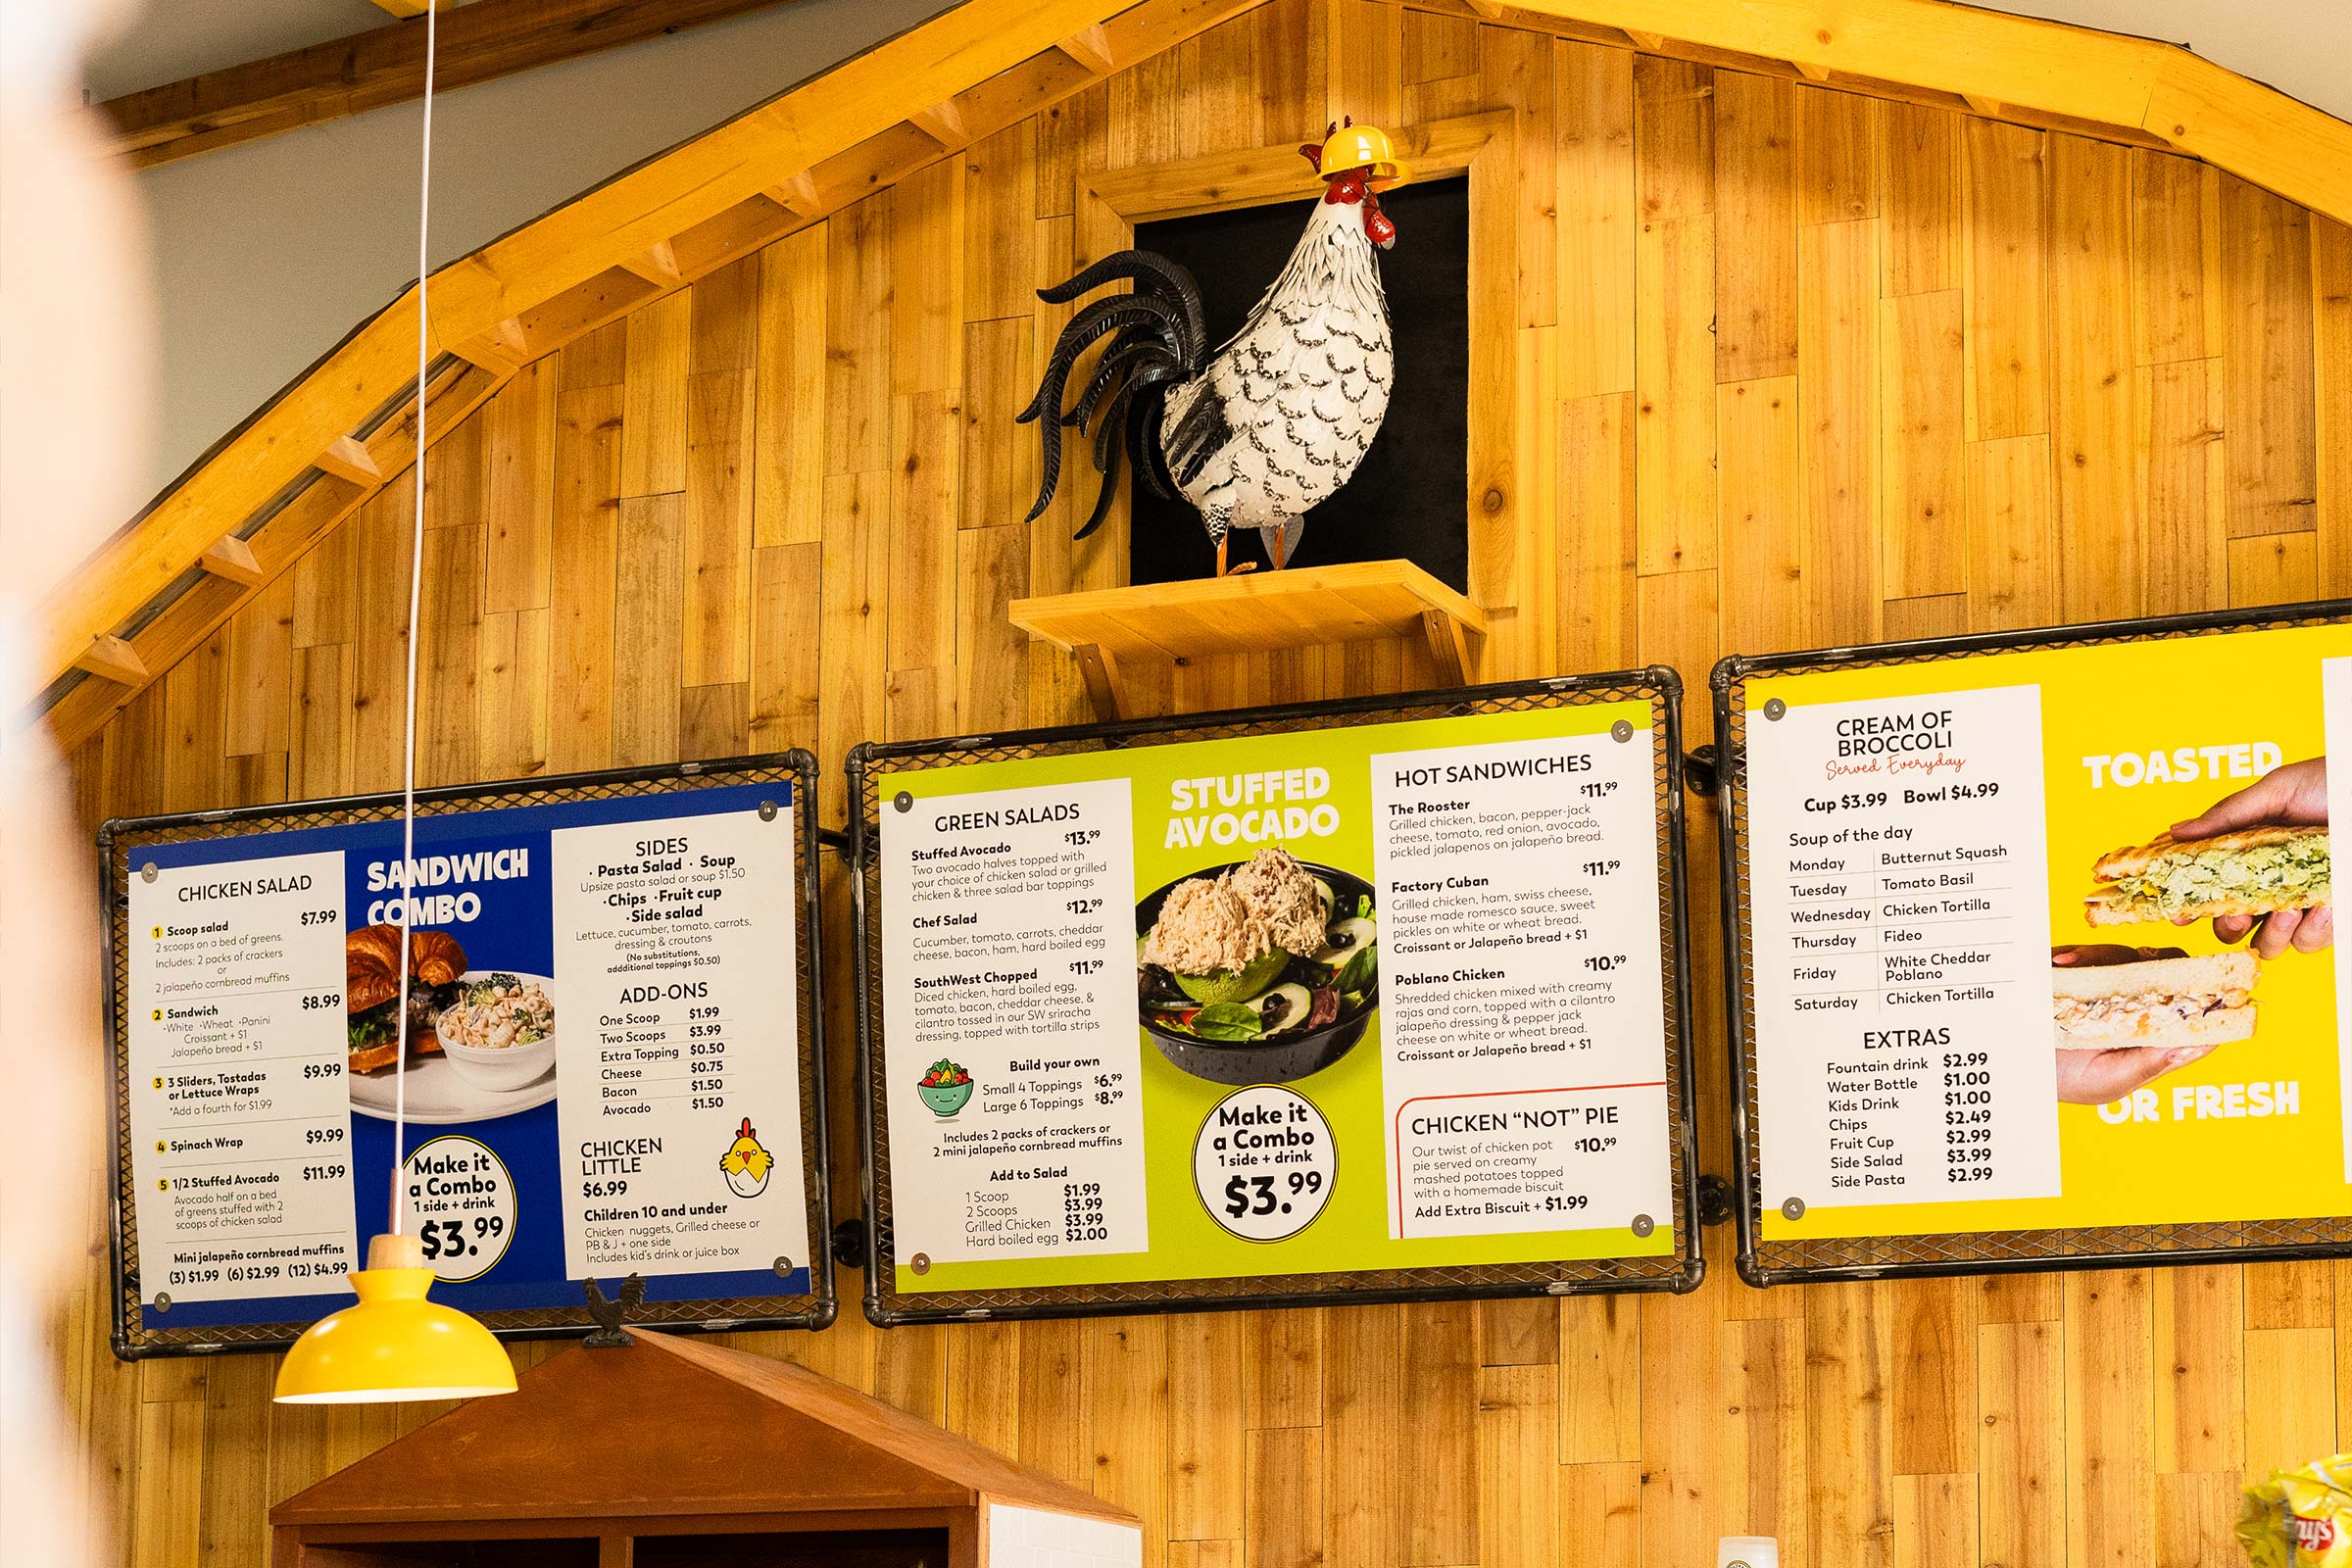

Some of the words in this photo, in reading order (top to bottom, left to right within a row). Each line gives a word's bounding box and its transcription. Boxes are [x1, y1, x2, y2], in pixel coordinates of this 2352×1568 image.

[1836, 712, 1914, 737] CREAM
[1921, 710, 1952, 729] OF
[1838, 730, 1951, 758] BROCCOLI
[1395, 767, 1442, 788] HOT
[1446, 754, 1592, 783] SANDWICHES
[1826, 757, 1882, 780] Served
[1886, 752, 1966, 776] Everyday
[2082, 741, 2283, 789] TOASTED
[1171, 766, 1330, 811] STUFFED
[1388, 803, 1414, 815] The
[1417, 800, 1470, 813] Rooster
[1580, 781, 1618, 798] $11.99
[1803, 798, 1837, 814] Cup
[1840, 792, 1887, 809] $3.99
[1903, 786, 1946, 804] Bowl
[1950, 782, 1999, 801] $4.99
[934, 810, 999, 832] GREEN
[1004, 803, 1080, 826] SALADS
[1164, 804, 1340, 849] AVOCADO
[1389, 817, 1426, 830] Grilled
[1429, 814, 1476, 827] chicken,
[1478, 811, 1518, 823] bacon,
[1521, 803, 1591, 822] pepper-jack
[635, 837, 688, 857] SIDES
[911, 846, 957, 861] Stuffed
[959, 841, 1011, 857] Avocado
[1064, 829, 1101, 846] $13.99
[1788, 832, 1829, 848] Soup
[1833, 828, 1849, 843] of
[1852, 827, 1879, 842] the
[1884, 825, 1913, 841] day
[367, 848, 528, 892] SANDWICH
[1789, 857, 1845, 872] Monday
[1881, 850, 1952, 865] Butternut
[1955, 844, 2007, 861] Squash
[177, 880, 252, 903] CHICKEN
[257, 874, 312, 895] SALAD
[580, 881, 613, 894] Upsize
[616, 878, 645, 891] pasta
[648, 873, 675, 886] salad
[691, 872, 715, 883] soup
[718, 866, 745, 880] $1.50
[1392, 881, 1443, 893] Factory
[1446, 875, 1489, 888] Cuban
[1583, 859, 1621, 876] $11.99
[1789, 882, 1847, 897] Tuesday
[1881, 877, 1936, 891] Tomato
[1939, 871, 1974, 886] Basil
[368, 892, 481, 927] COMBO
[912, 914, 941, 929] Chef
[943, 911, 977, 926] Salad
[1066, 898, 1102, 914] $12.99
[1790, 906, 1871, 923] Wednesday
[1883, 903, 1937, 916] Chicken
[1940, 898, 1990, 912] Tortilla
[154, 928, 160, 938] 1
[167, 925, 198, 937] Scoop
[200, 920, 228, 933] salad
[300, 909, 336, 926] $7.99
[1790, 933, 1856, 949] Thursday
[1884, 929, 1922, 943] Fideo
[1395, 972, 1449, 986] Poblano
[1452, 967, 1505, 981] Chicken
[1584, 955, 1627, 971] $10.99
[1884, 955, 1927, 968] White
[1930, 951, 1991, 965] Cheddar
[913, 973, 981, 989] SouthWest
[983, 967, 1038, 984] Chopped
[1069, 959, 1103, 975] $11.99
[1793, 966, 1837, 981] Friday
[1886, 968, 1942, 982] Poblano
[619, 981, 708, 1004] ADD-ONS
[154, 1010, 161, 1020] 2
[167, 1004, 219, 1019] Sandwich
[302, 994, 340, 1010] $8.99
[599, 1014, 623, 1026] One
[625, 1012, 660, 1025] Scoop
[689, 1005, 719, 1020] $1.99
[599, 1033, 623, 1044] Two
[625, 1031, 665, 1043] Scoops
[689, 1024, 721, 1038] $3.99
[1863, 1027, 1950, 1050] EXTRAS
[155, 1078, 163, 1088] 3
[168, 1077, 174, 1088] 3
[176, 1075, 216, 1087] Sliders,
[217, 1070, 267, 1084] Tostadas
[304, 1062, 341, 1079] $9.99
[1009, 1058, 1041, 1072] Build
[1043, 1059, 1071, 1072] your
[1073, 1057, 1100, 1067] own
[1827, 1059, 1888, 1074] Fountain
[1892, 1056, 1929, 1070] drink
[1942, 1052, 1987, 1068] $2.99
[602, 1087, 637, 1098] Bacon
[691, 1078, 723, 1092] $1.50
[982, 1082, 1015, 1096] Small
[1017, 1082, 1026, 1093] 4
[1027, 1079, 1082, 1095] Toppings
[1094, 1072, 1122, 1087] $6.99
[602, 1102, 651, 1116] Avocado
[692, 1097, 723, 1110] $1.50
[983, 1101, 1016, 1114] Large
[1019, 1099, 1027, 1110] 6
[1029, 1097, 1084, 1111] Toppings
[1094, 1090, 1123, 1104] $8.99
[1219, 1104, 1283, 1127] Make
[1289, 1102, 1307, 1122] it
[2097, 1089, 2159, 1125] OR
[2173, 1081, 2299, 1120] FRESH
[1411, 1112, 1507, 1135] CHICKEN
[1585, 1105, 1619, 1125] PIE
[1829, 1118, 1868, 1133] Chips
[1945, 1108, 1991, 1125] $2.49
[158, 1143, 165, 1152] 4
[171, 1138, 213, 1153] Spinach
[214, 1137, 243, 1149] Wrap
[306, 1128, 343, 1145] $9.99
[580, 1137, 662, 1158] CHICKEN
[1213, 1137, 1227, 1151] a
[1234, 1126, 1314, 1149] Combo
[1574, 1137, 1617, 1152] $10.99
[1830, 1137, 1863, 1150] Fruit
[1866, 1136, 1894, 1151] Cup
[1945, 1128, 1991, 1145] $2.99
[581, 1156, 642, 1176] LITTLE
[1218, 1154, 1225, 1167] 1
[1229, 1153, 1258, 1166] side
[1262, 1154, 1271, 1163] +
[1275, 1150, 1312, 1164] drink
[1830, 1155, 1860, 1169] Side
[1863, 1152, 1902, 1167] Salad
[1946, 1148, 1991, 1164] $3.99
[161, 1181, 167, 1191] 5
[172, 1177, 189, 1191] 1/2
[191, 1174, 232, 1188] Stuffed
[233, 1171, 279, 1185] Avocado
[303, 1164, 345, 1181] $11.99
[989, 1168, 1014, 1182] Add
[1016, 1169, 1030, 1180] to
[1033, 1165, 1067, 1179] Salad
[582, 1180, 627, 1199] $6.99
[1225, 1170, 1322, 1219] $3.99
[1414, 1204, 1441, 1218] Add
[1445, 1204, 1481, 1216] Extra
[1485, 1200, 1531, 1214] Biscuit
[1544, 1195, 1588, 1211] $1.99
[420, 1216, 504, 1260] $3.99
[586, 1251, 627, 1262] Includes
[654, 1248, 680, 1259] drink
[694, 1247, 718, 1259] juice
[720, 1245, 740, 1255] box
[169, 1269, 185, 1285] (3)
[188, 1269, 219, 1284] $1.99
[226, 1266, 244, 1282] (6)
[246, 1265, 279, 1280] $2.99
[287, 1262, 311, 1278] (12)
[314, 1261, 348, 1276] $4.99
